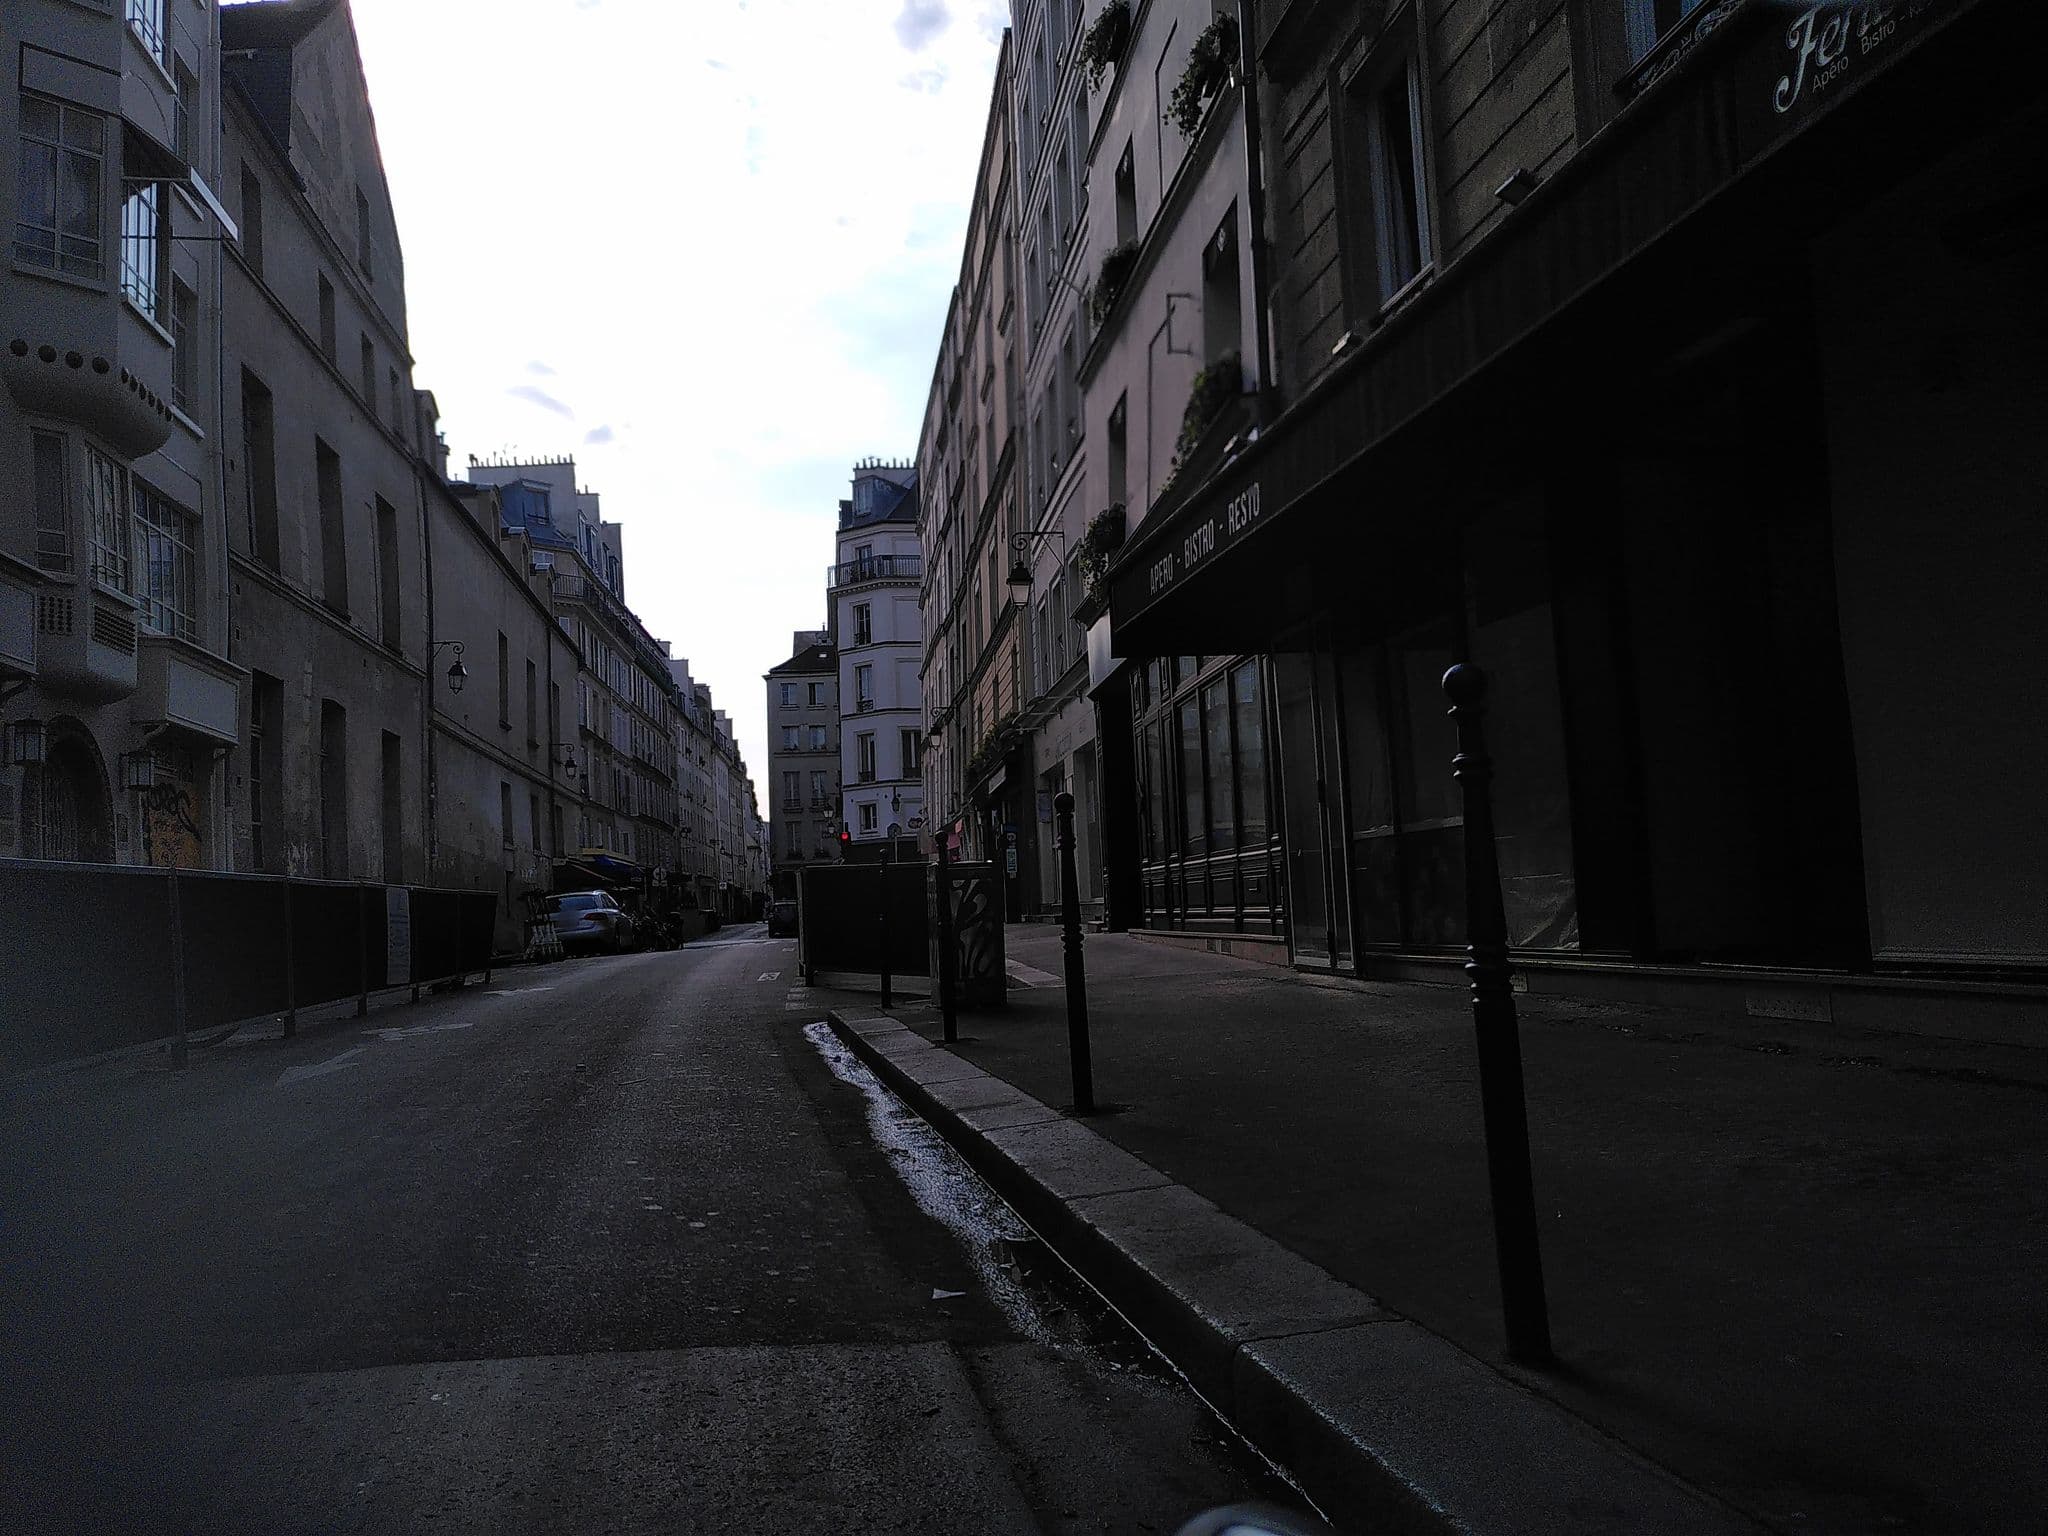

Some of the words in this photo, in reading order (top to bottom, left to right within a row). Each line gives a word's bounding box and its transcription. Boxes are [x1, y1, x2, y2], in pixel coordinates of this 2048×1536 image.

[1860, 19, 1896, 56] Bistro
[1150, 552, 1174, 596] APERO
[1184, 518, 1215, 569] BISTRO
[1228, 482, 1260, 536] RESTO
